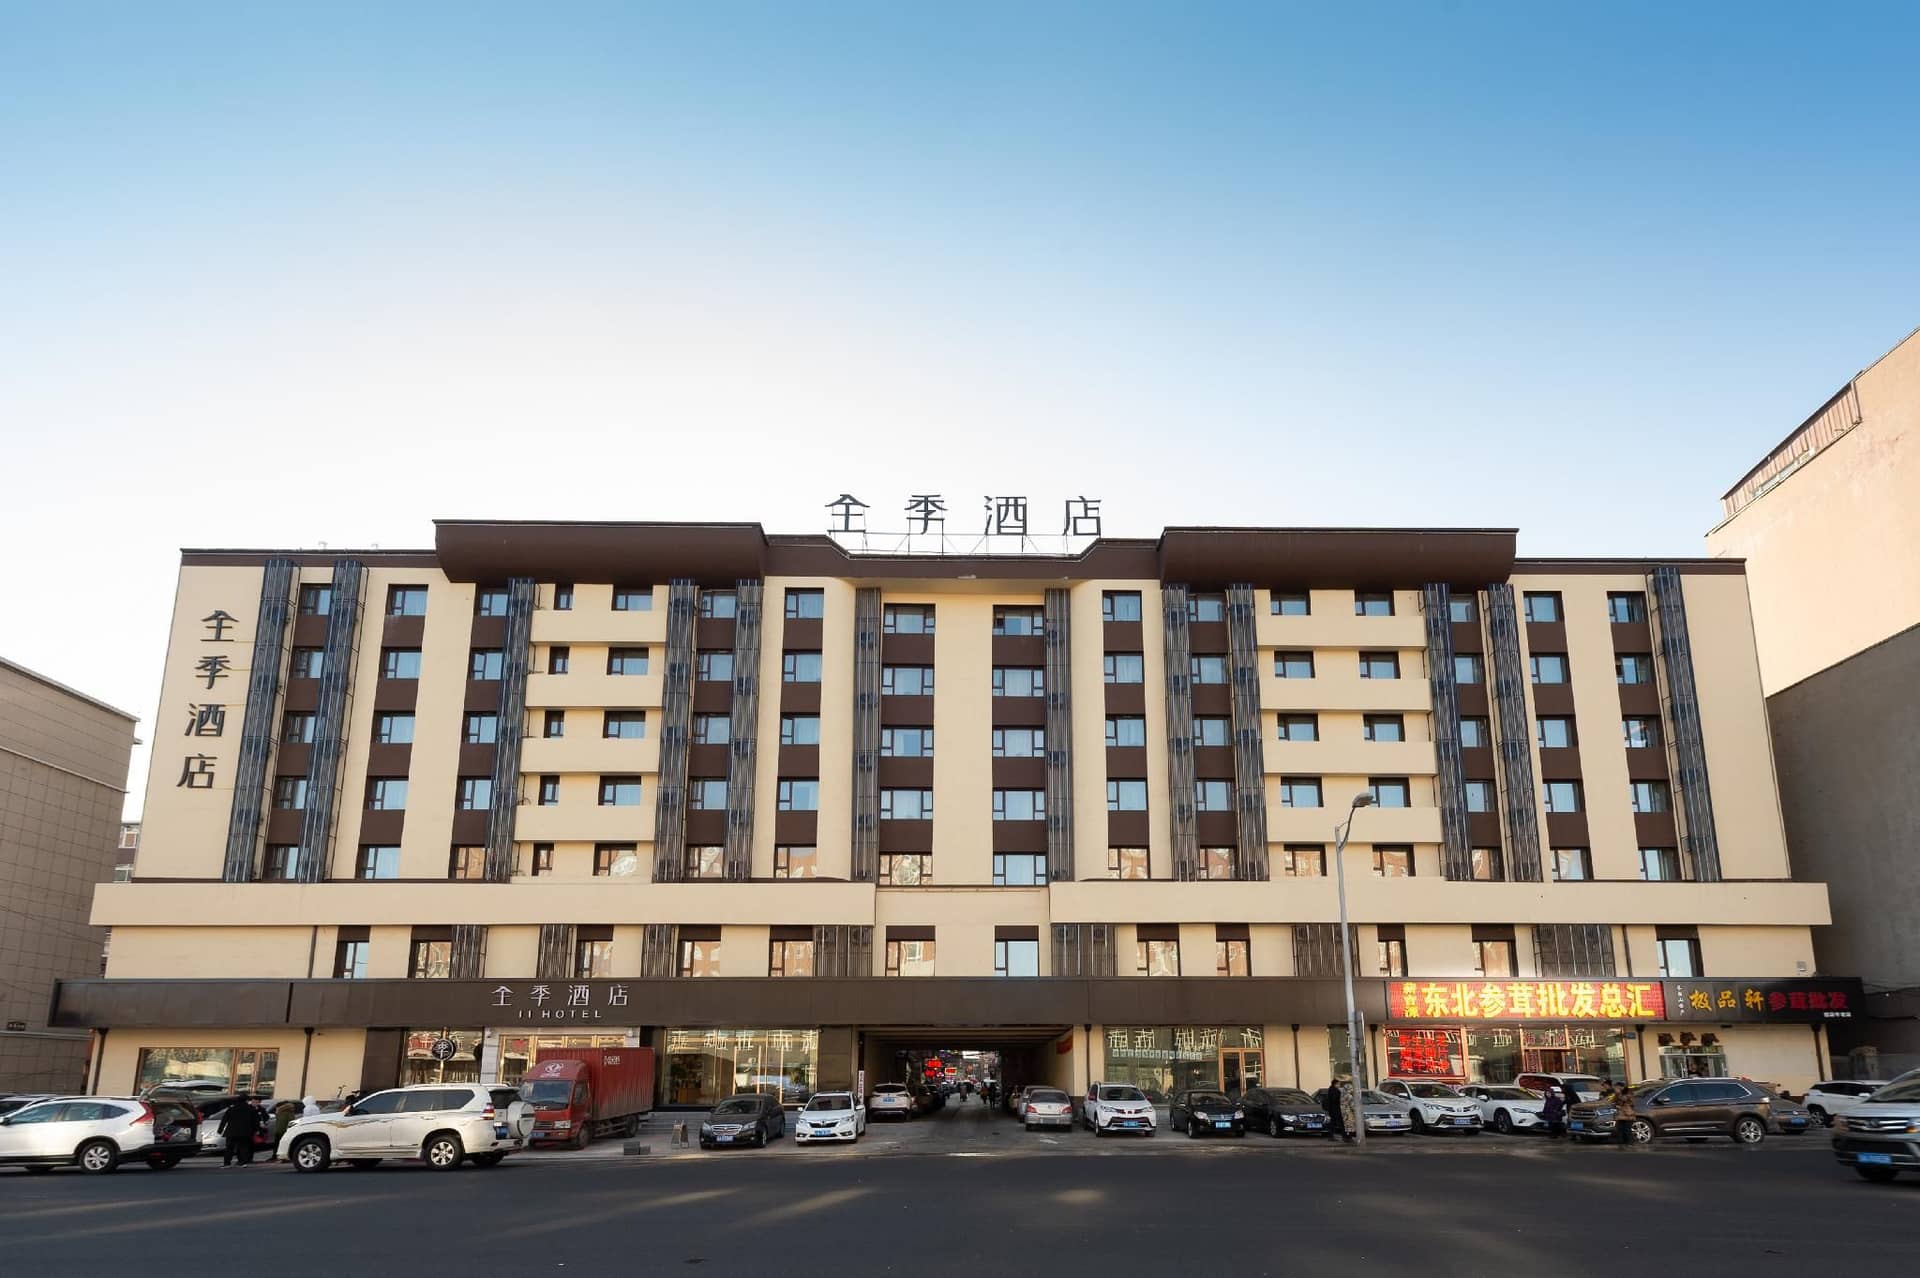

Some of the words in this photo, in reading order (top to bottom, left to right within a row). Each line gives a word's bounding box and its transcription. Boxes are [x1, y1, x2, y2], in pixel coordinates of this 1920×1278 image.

[825, 494, 1101, 536] 全季酒店
[176, 609, 239, 789] 全季酒店
[490, 984, 630, 1007] 全季酒店
[1421, 982, 1656, 1018] 东北参茸批发总汇
[1688, 988, 1764, 1012] 极品轩
[541, 1009, 602, 1020] HOTEL
